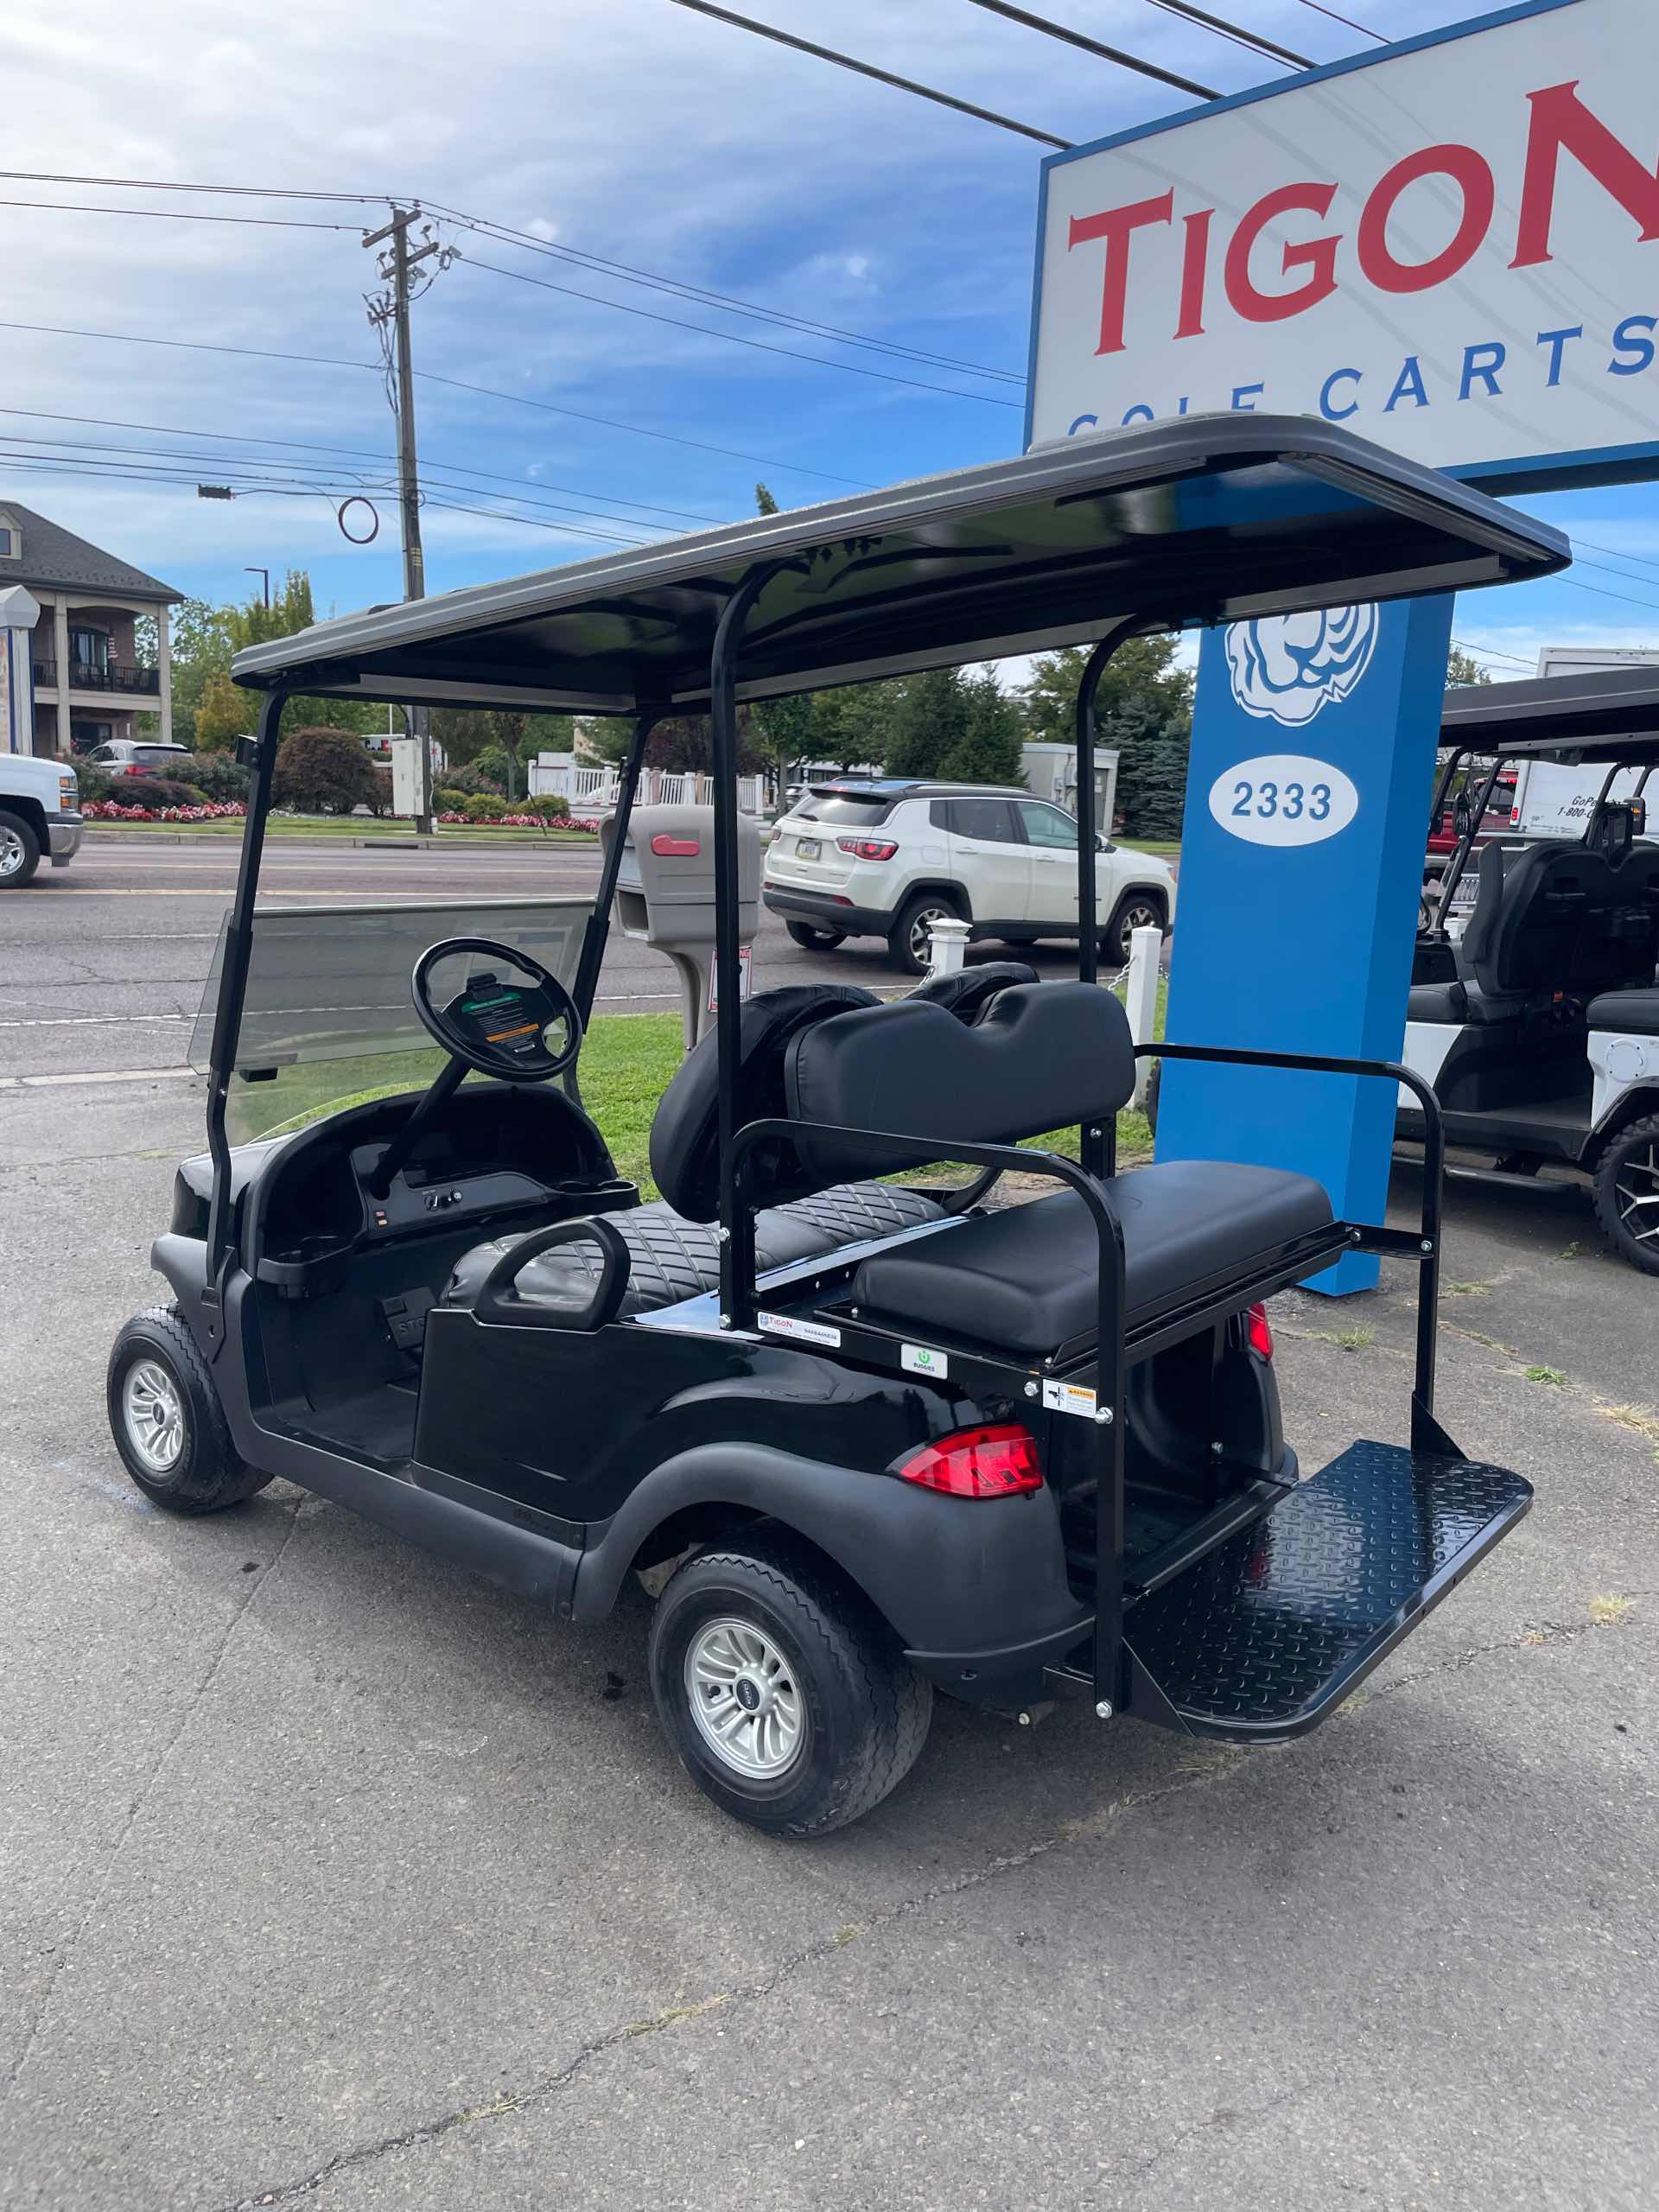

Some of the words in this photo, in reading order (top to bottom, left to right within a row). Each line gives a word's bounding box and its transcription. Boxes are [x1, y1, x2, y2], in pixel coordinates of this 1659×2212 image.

[1068, 80, 1659, 355] TIGON
[1319, 315, 1658, 421] CARTS
[1231, 781, 1331, 820] 2333
[1572, 795, 1597, 806] GoPe
